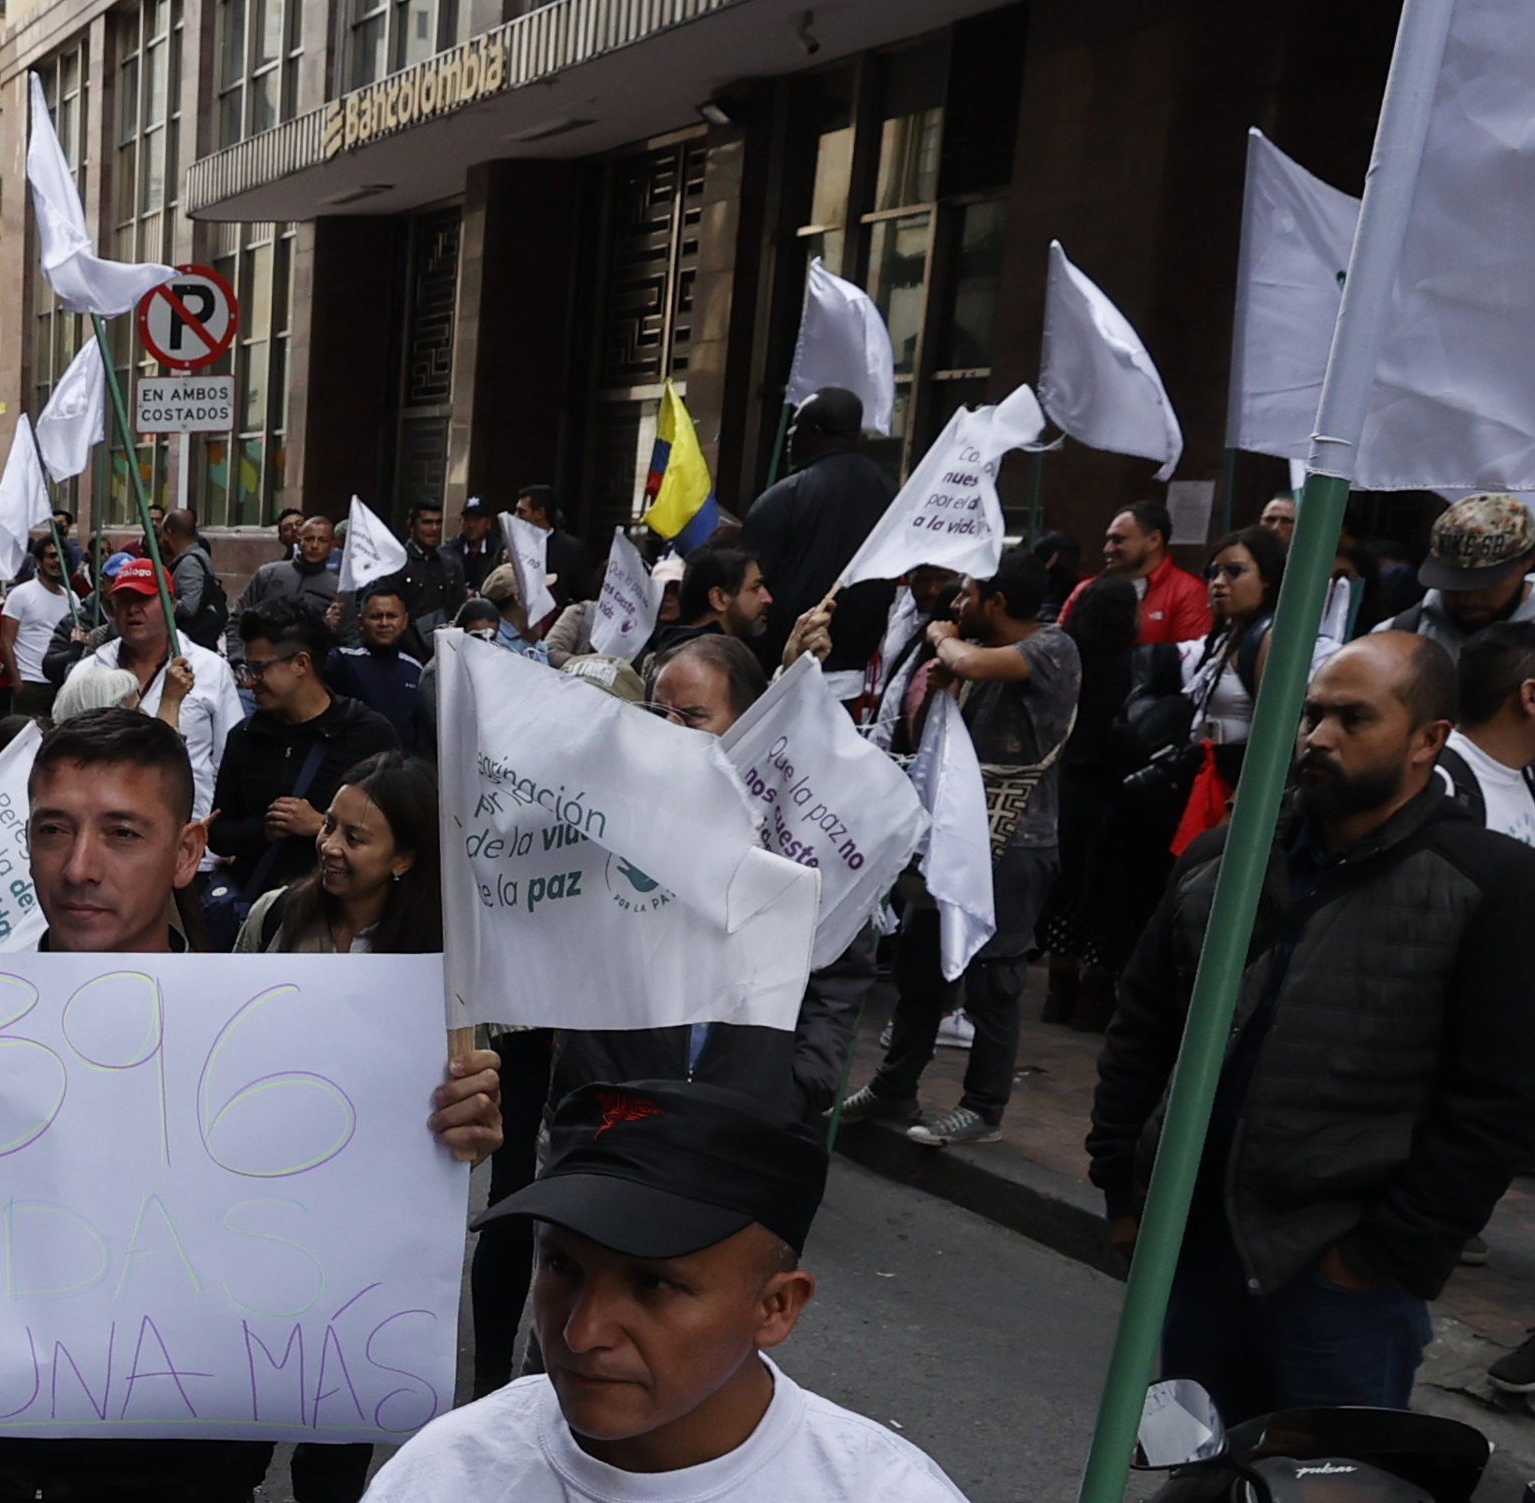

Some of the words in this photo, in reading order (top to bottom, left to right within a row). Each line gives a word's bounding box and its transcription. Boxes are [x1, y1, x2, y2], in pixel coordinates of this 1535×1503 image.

[345, 33, 504, 147] Bancolombia
[142, 388, 164, 402] EN
[170, 387, 229, 401] AMBOS
[141, 406, 229, 422] COSTADOS
[942, 471, 979, 487] nues
[926, 515, 945, 531] la
[767, 735, 795, 783] Que
[744, 767, 778, 803] nos
[789, 776, 814, 806] la
[801, 803, 848, 844] paz
[466, 828, 504, 859] de
[508, 825, 533, 858] la
[838, 838, 865, 871] no
[497, 874, 518, 907] la
[527, 871, 583, 913] paz
[242, 1281, 439, 1433] MÁS
